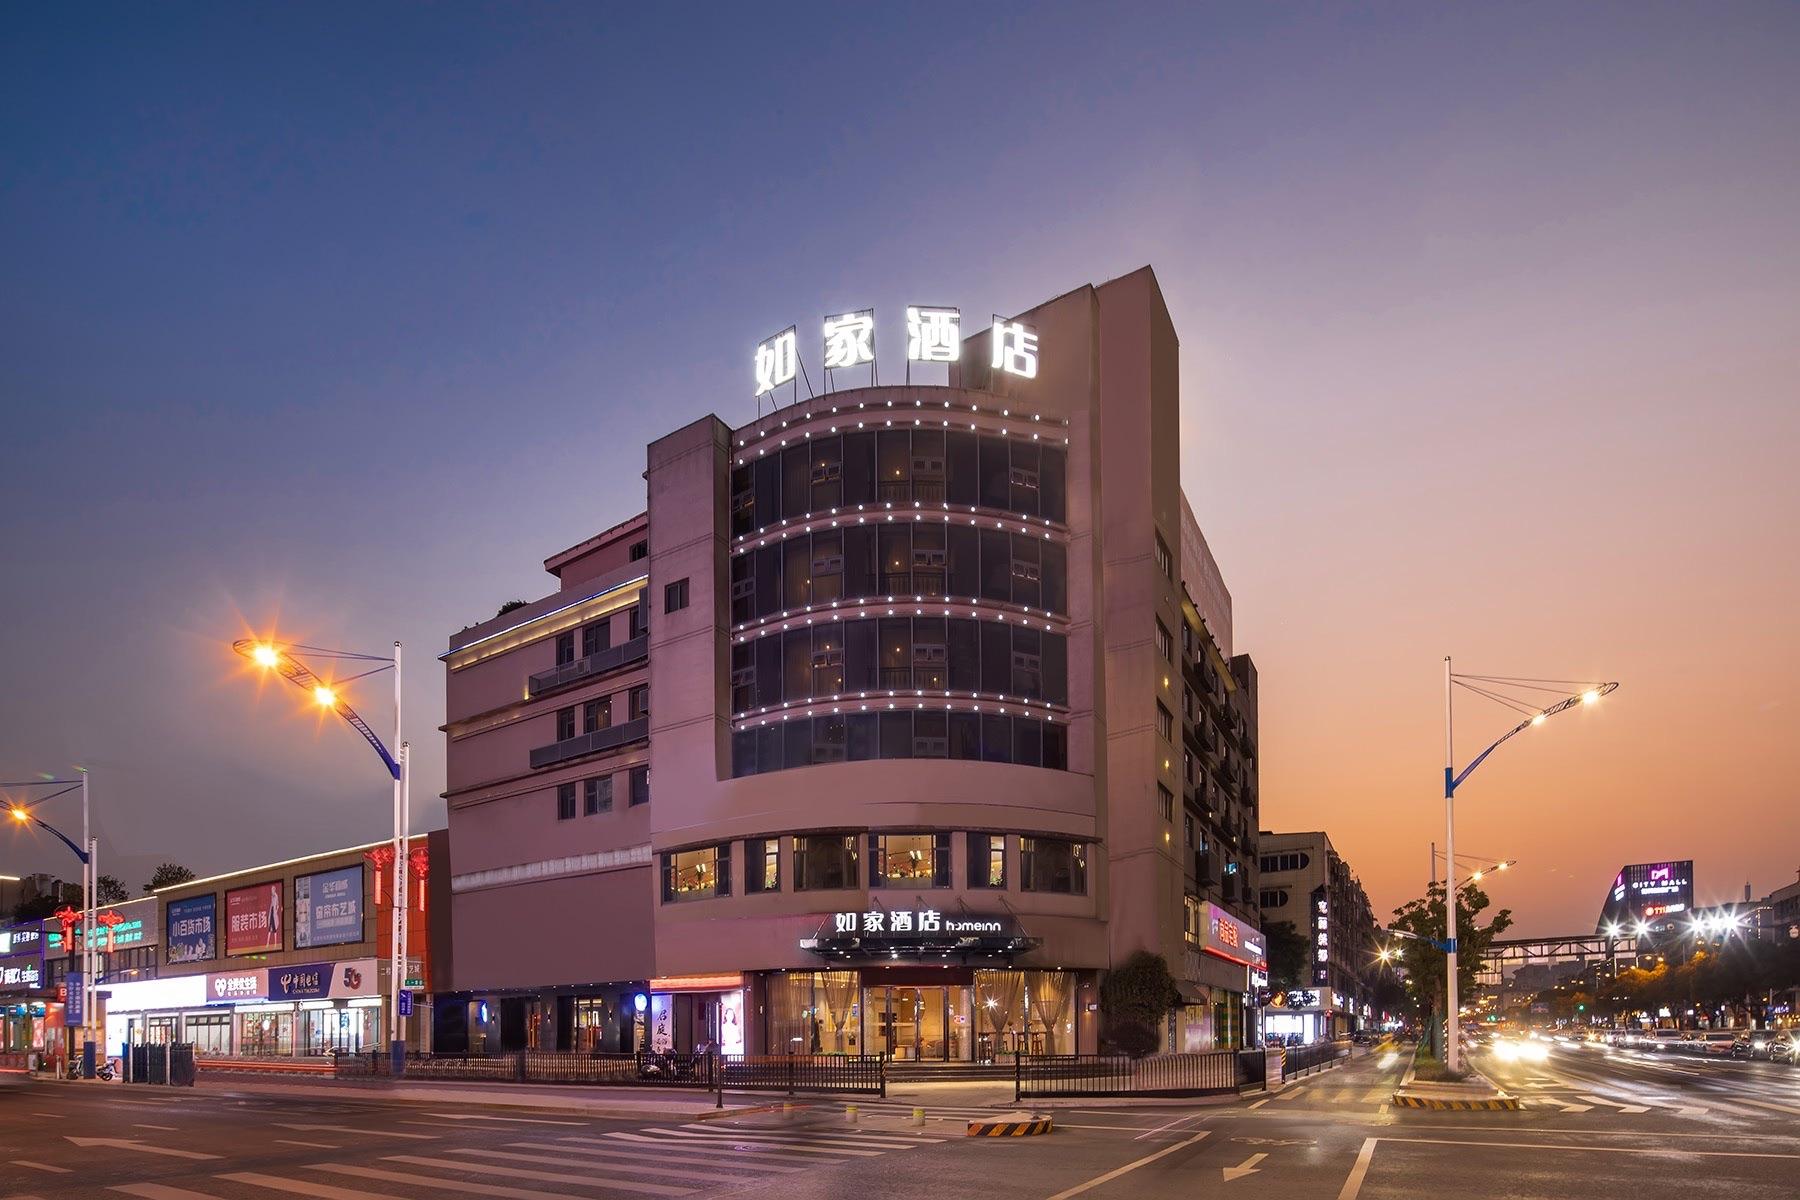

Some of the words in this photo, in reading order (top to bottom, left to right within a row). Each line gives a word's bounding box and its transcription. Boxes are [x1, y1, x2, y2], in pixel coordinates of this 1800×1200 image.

[755, 305, 1038, 396] 如家酒店
[1632, 881, 1656, 889] CITY
[1661, 878, 1687, 887] MALL
[172, 916, 211, 937] 小百货市场
[231, 910, 268, 932] 服装市场
[835, 910, 940, 933] 如家酒店
[293, 972, 319, 988] 中国电信
